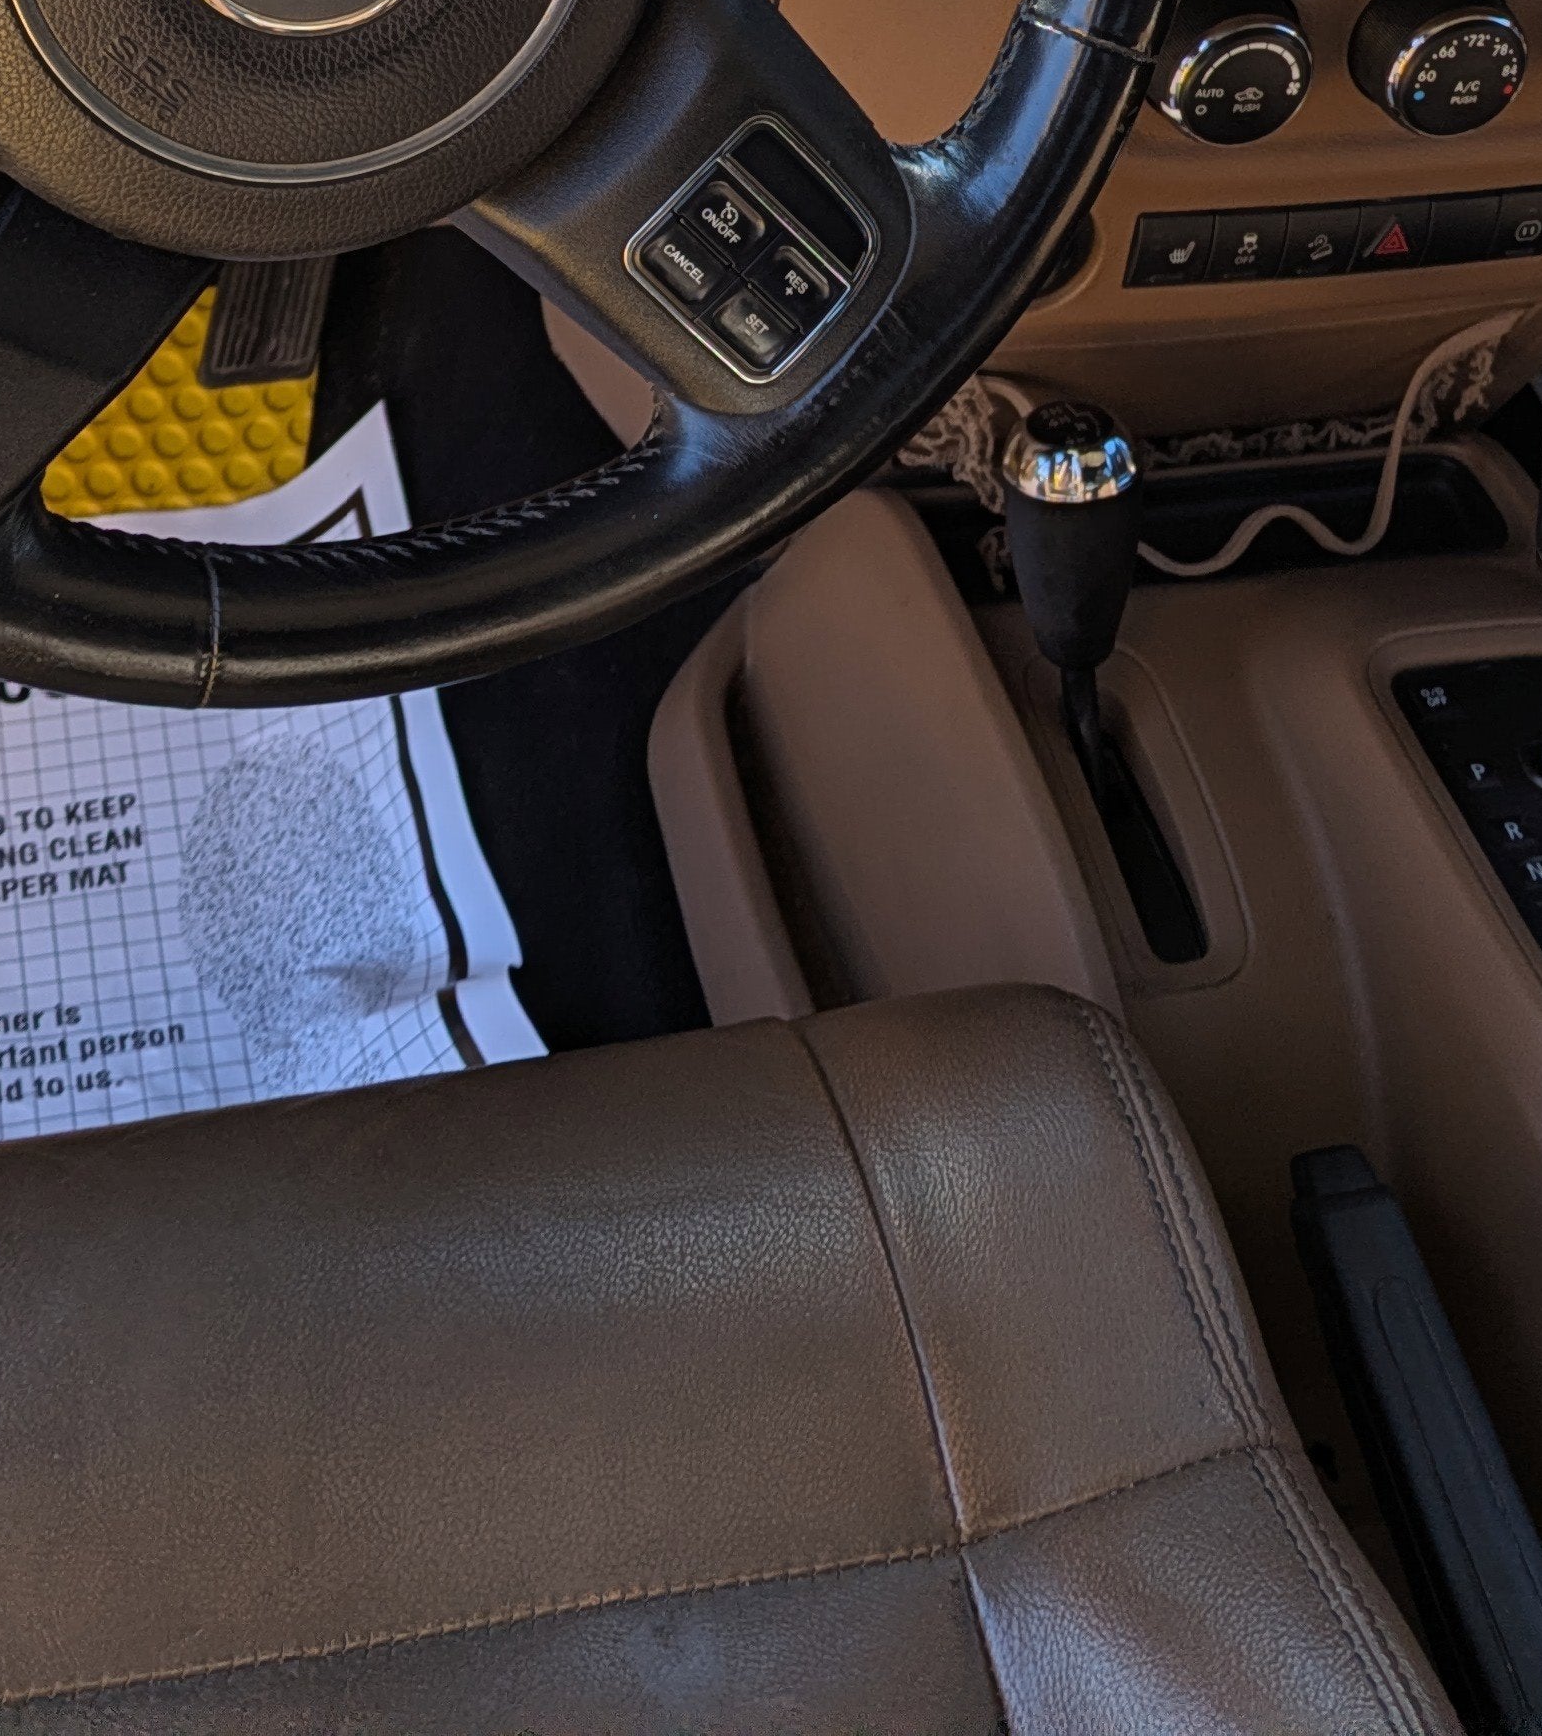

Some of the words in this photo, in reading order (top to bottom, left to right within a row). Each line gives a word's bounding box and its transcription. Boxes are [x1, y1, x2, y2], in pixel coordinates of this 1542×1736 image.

[1467, 33, 1487, 48] 72
[1491, 43, 1510, 58] 78
[1417, 69, 1437, 84] 60
[1500, 64, 1519, 78] 84
[1194, 87, 1225, 99] AUTO
[1454, 79, 1481, 95] A/C
[1232, 102, 1261, 114] PUSH
[1450, 94, 1478, 106] PUSH
[701, 206, 742, 245] ON/OFF
[662, 243, 706, 286] CANCEL
[784, 269, 809, 295] RES
[744, 312, 770, 336] SET
[1469, 762, 1486, 782] P
[14, 805, 55, 834] TO
[65, 793, 139, 826] KEEP
[1504, 821, 1524, 841] R
[48, 824, 144, 862] CLEAN
[66, 859, 134, 892] MAT
[55, 1002, 84, 1026] is
[79, 1021, 188, 1063] person
[33, 1072, 65, 1100] to
[74, 1066, 125, 1095] us.
